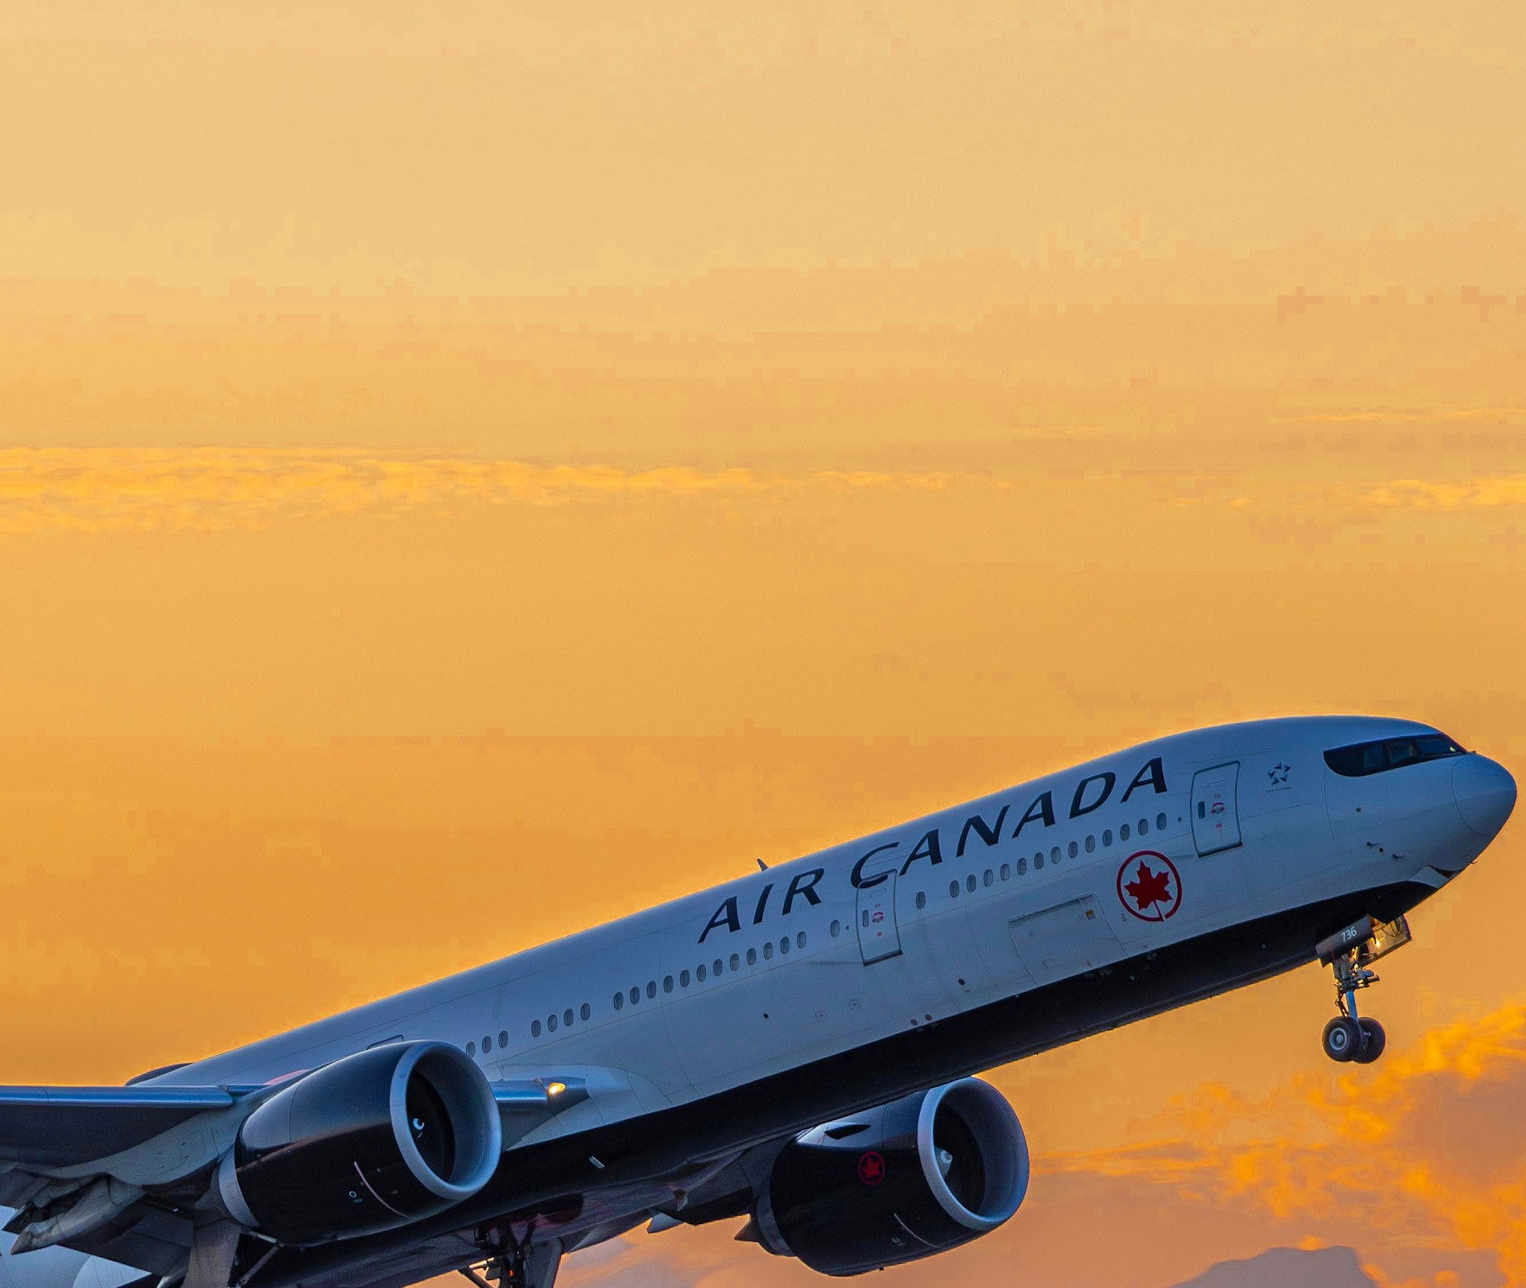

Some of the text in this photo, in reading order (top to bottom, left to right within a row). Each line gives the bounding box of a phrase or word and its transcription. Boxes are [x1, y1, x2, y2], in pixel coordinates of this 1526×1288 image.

[697, 756, 1168, 944] AIR CANADA
[1340, 926, 1358, 942] 736
